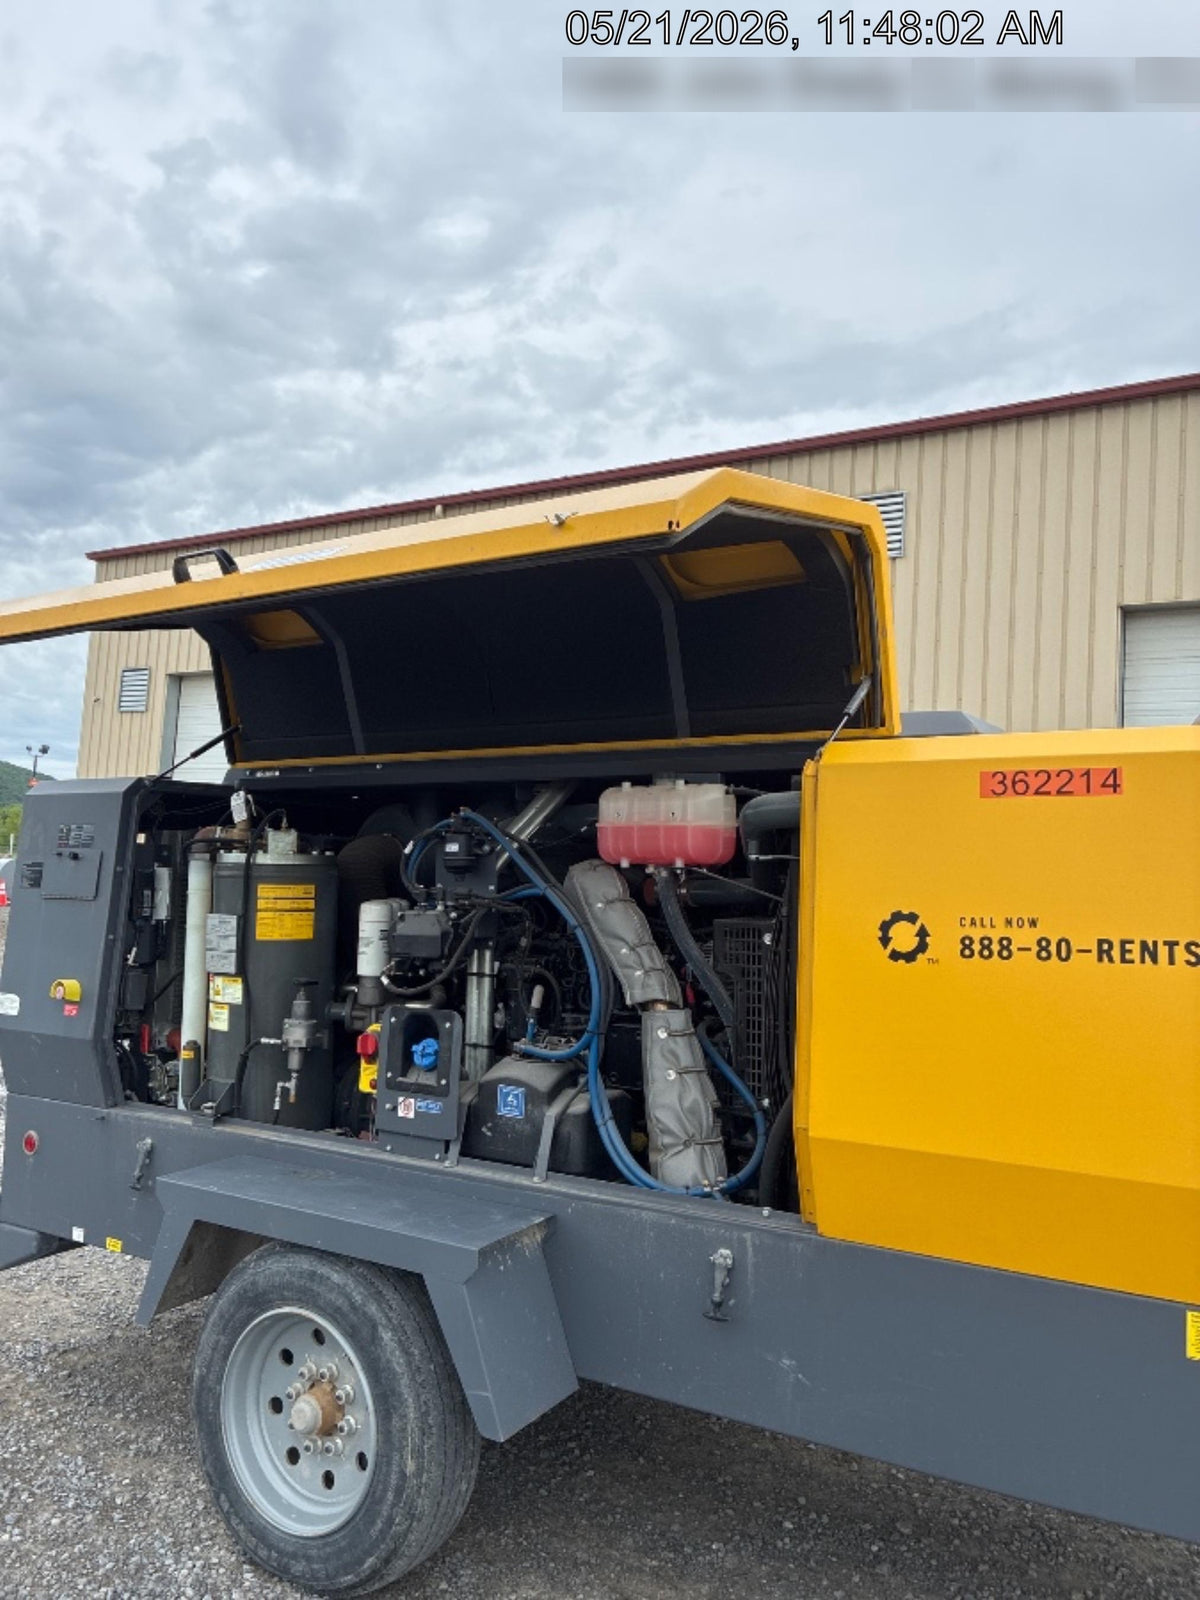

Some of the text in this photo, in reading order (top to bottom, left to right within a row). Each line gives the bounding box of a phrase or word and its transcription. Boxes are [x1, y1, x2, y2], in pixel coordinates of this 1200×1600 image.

[990, 767, 1121, 796] 362214
[959, 916, 1039, 929] CALL NOW
[959, 934, 1200, 968] 888-80-RENTS
